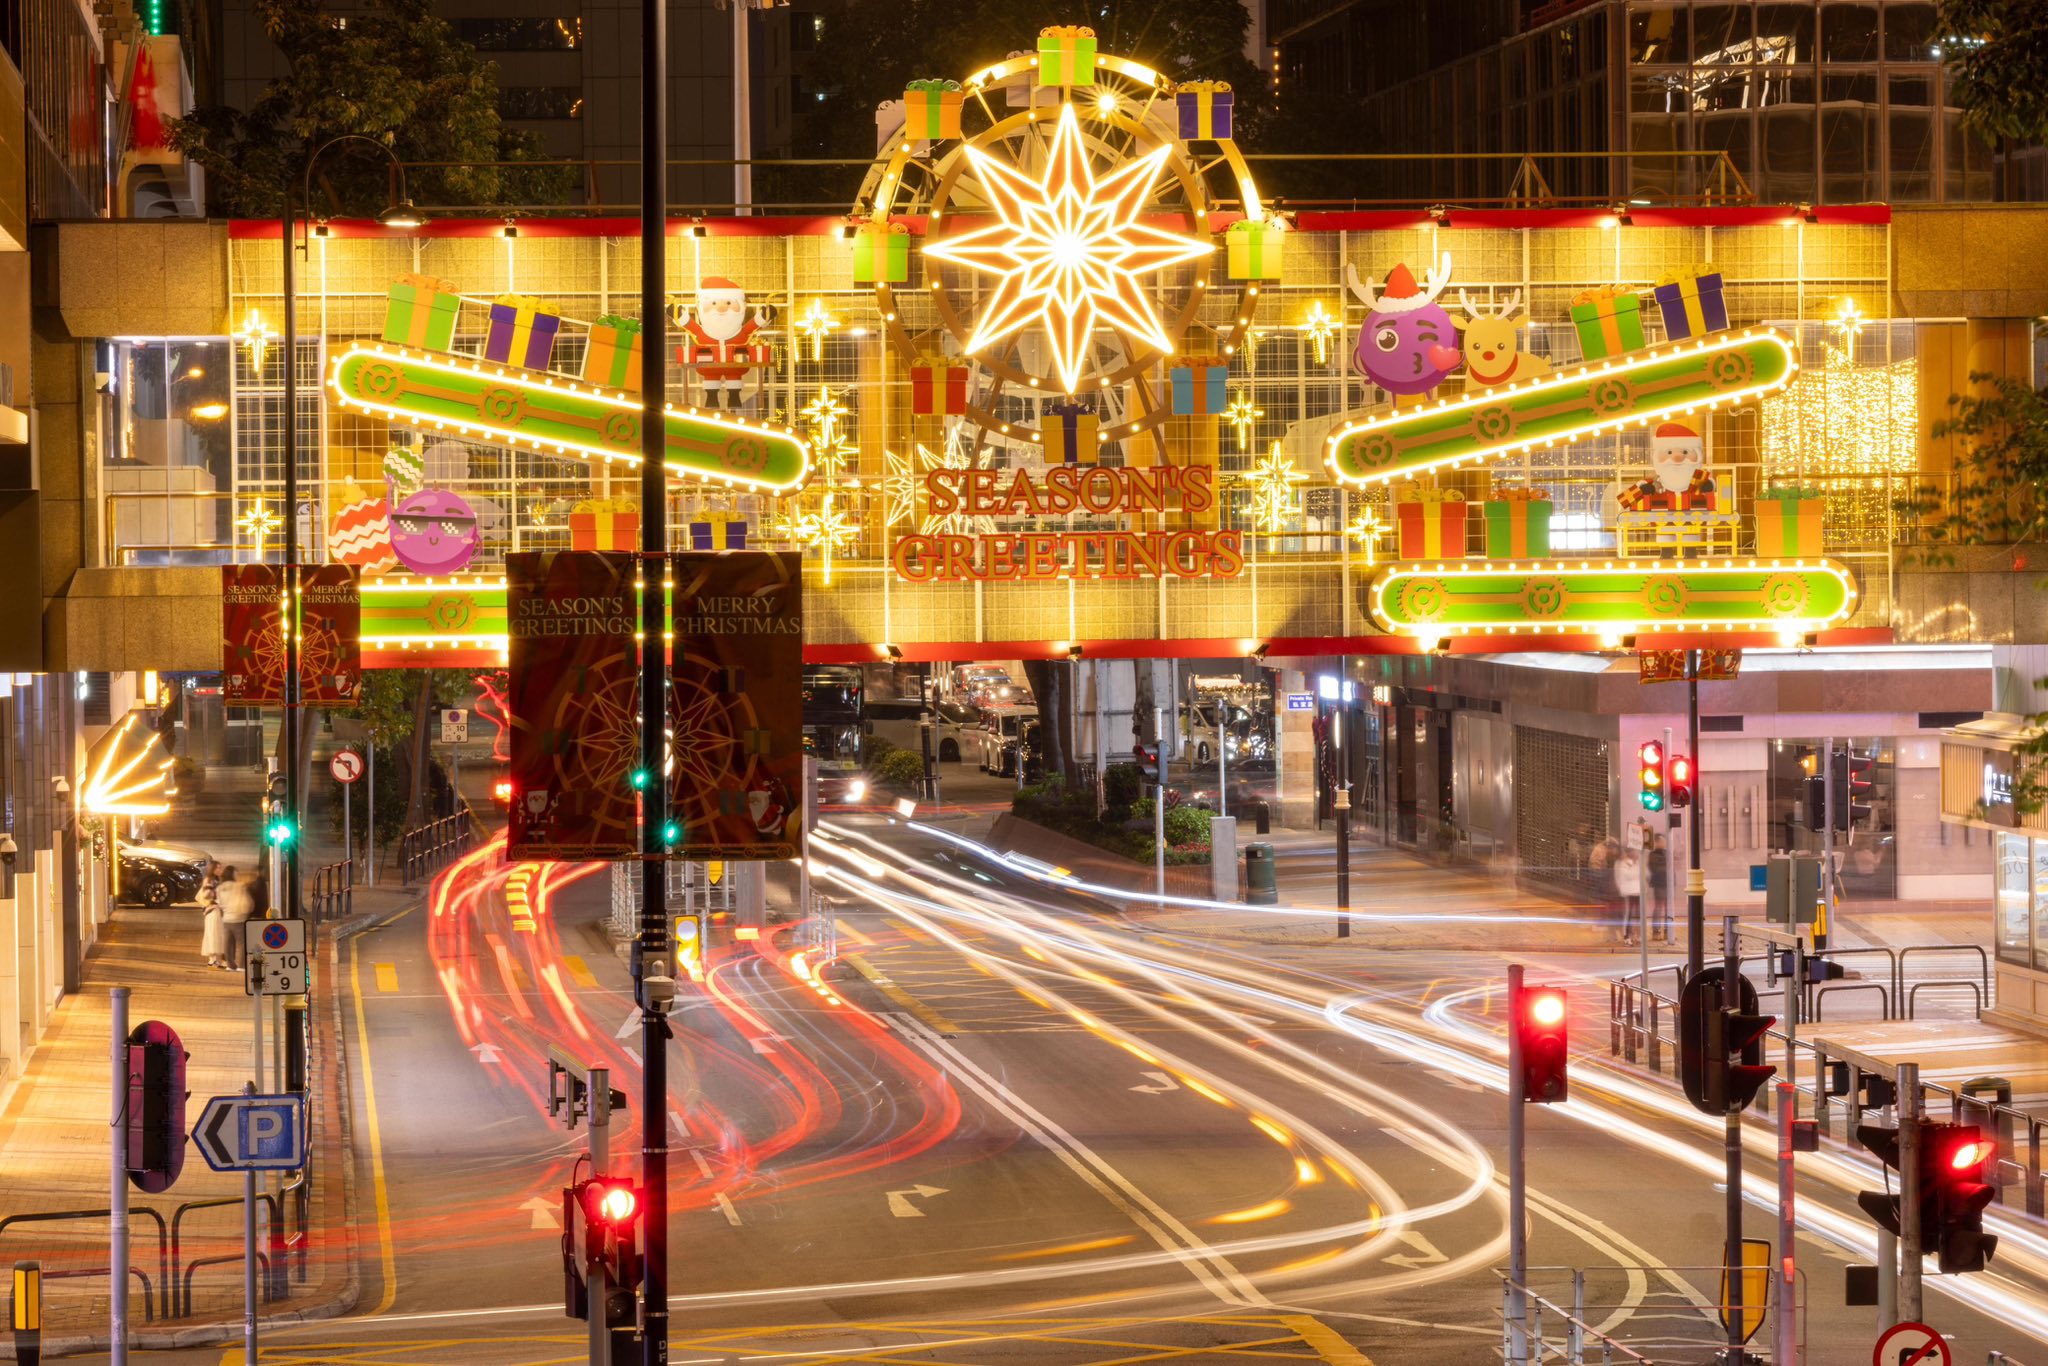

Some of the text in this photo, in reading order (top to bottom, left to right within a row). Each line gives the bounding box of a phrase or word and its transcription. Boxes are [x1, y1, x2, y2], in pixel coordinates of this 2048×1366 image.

[927, 464, 1213, 515] SEASON'S
[893, 529, 1245, 582] GREETINGS
[228, 585, 277, 594] SEASON'S
[312, 585, 349, 594] MERRY
[224, 595, 281, 604] GREETINGS
[302, 594, 360, 604] CHRISTMAS
[519, 596, 624, 616] SEASON'S
[697, 596, 776, 614] MERRY
[511, 616, 634, 636] GREETINGS
[673, 616, 801, 635] CHRISTMAS
[280, 955, 299, 969] 10
[280, 976, 291, 991] 9
[248, 1110, 283, 1156] P
